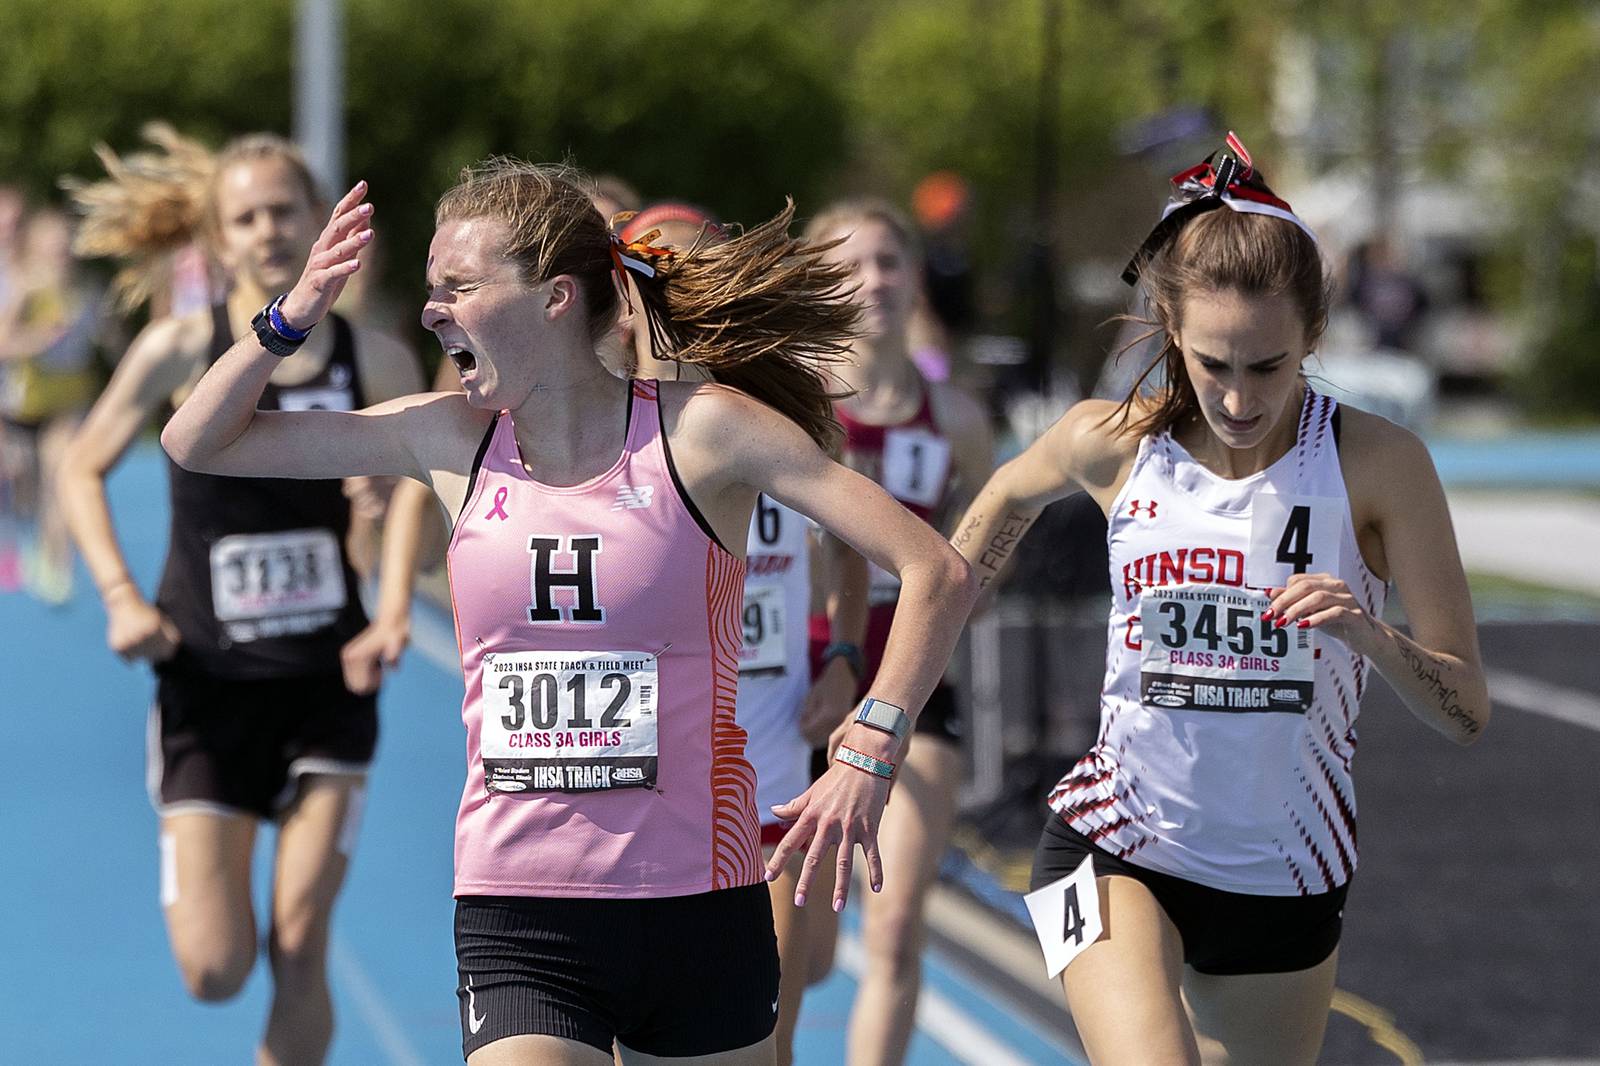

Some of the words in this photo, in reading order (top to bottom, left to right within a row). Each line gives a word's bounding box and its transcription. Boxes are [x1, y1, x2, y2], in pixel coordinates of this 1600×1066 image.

[757, 492, 780, 545] 6
[1276, 505, 1313, 575] 4
[528, 535, 605, 623] H
[1123, 548, 1247, 601] HINSD
[1153, 589, 1174, 598] 2023
[1176, 591, 1195, 601] IHSA
[1198, 592, 1220, 603] STATE
[1222, 594, 1247, 605] TRACK
[1159, 602, 1288, 658] 3455
[494, 663, 513, 672] 2023
[516, 662, 533, 671] IHSA
[535, 661, 557, 671] STATE
[560, 661, 587, 670] TRACK
[598, 661, 620, 670] FIELD
[623, 661, 645, 670] MEET
[1170, 650, 1213, 667] CLASS
[1218, 655, 1236, 670] 3A
[1240, 656, 1280, 672] GIRLS
[499, 673, 632, 731] 3012
[1194, 684, 1226, 707] IHSA
[1227, 686, 1269, 708] TRACK
[509, 732, 551, 748] CLASS
[556, 732, 574, 747] 3A
[579, 731, 621, 747] GIRLS
[534, 766, 565, 789] IHSA
[566, 766, 611, 788] TRACK
[1063, 882, 1086, 946] 4
